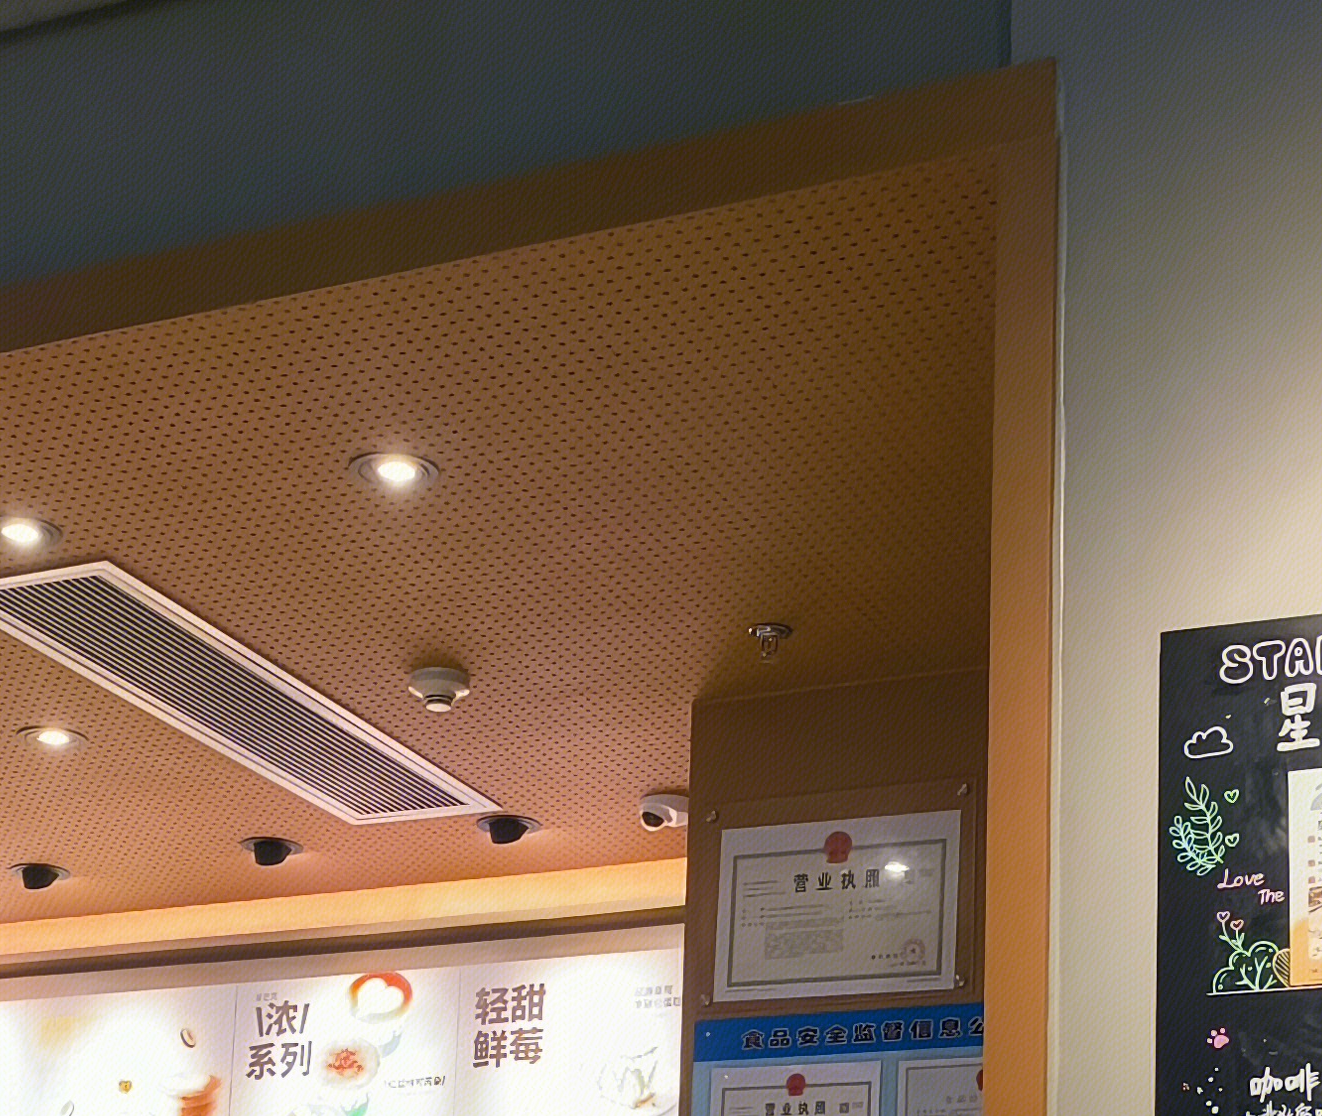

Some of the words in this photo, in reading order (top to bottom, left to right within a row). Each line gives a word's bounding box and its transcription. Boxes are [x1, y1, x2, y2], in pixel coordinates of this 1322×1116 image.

[793, 868, 880, 894] 营业执照
[1217, 868, 1265, 889] Love
[1257, 888, 1285, 905] The
[474, 982, 547, 1026] 轻甜
[244, 1041, 313, 1080] 系列
[472, 1027, 545, 1069] 鲜莓
[765, 1101, 826, 1116] 营业执照
